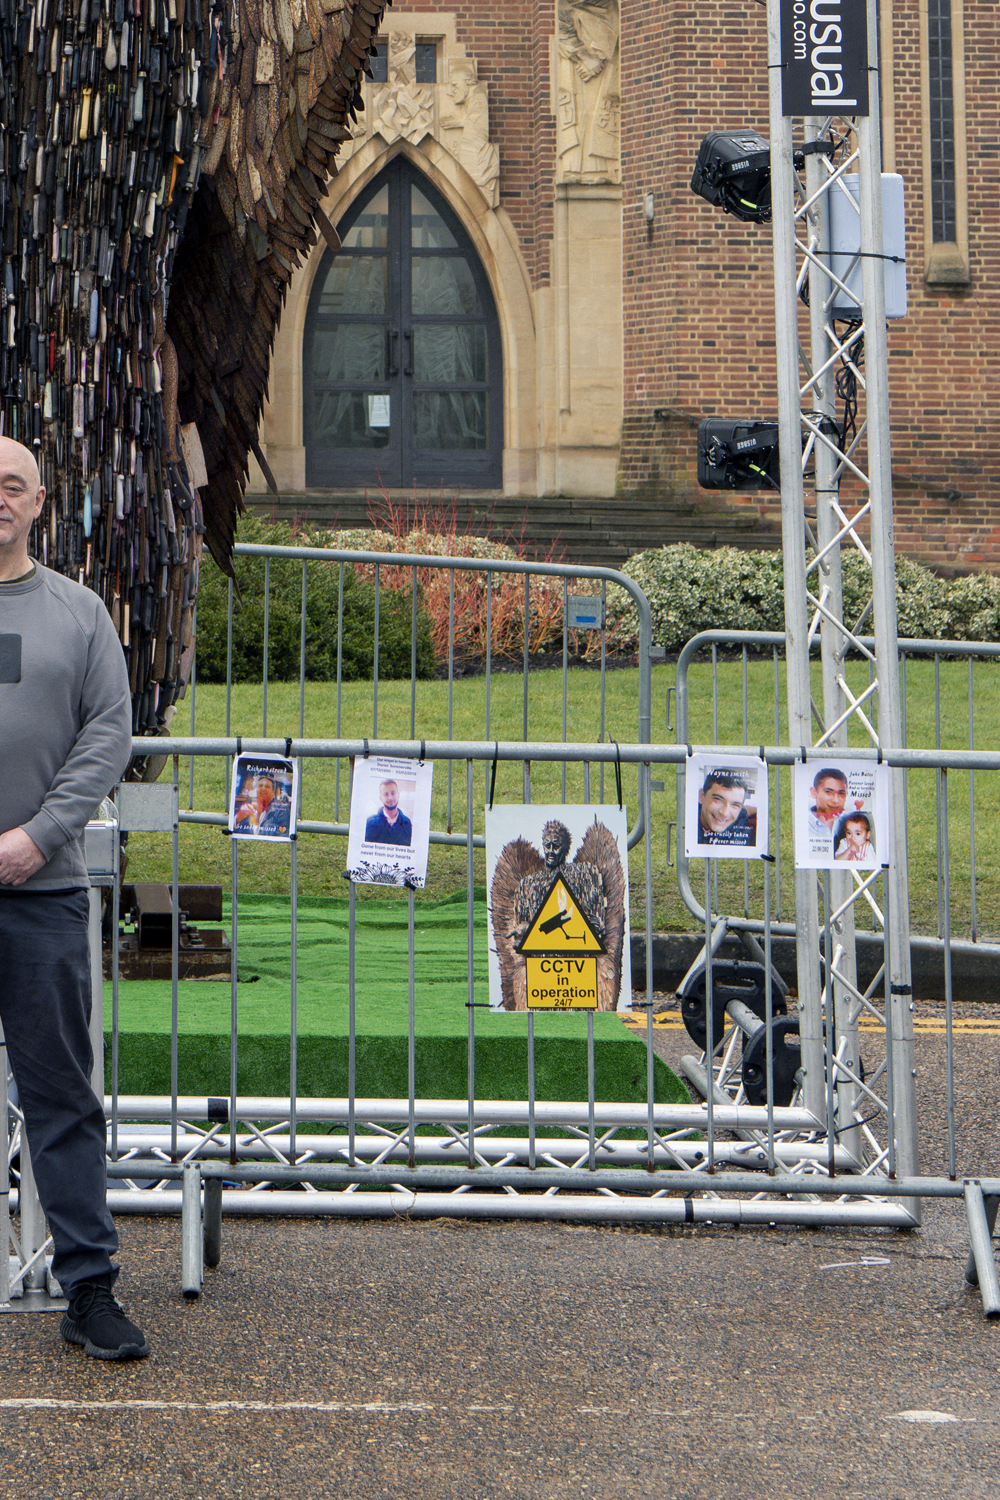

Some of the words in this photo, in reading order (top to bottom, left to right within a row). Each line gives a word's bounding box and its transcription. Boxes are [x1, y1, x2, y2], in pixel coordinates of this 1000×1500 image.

[246, 764, 268, 773] Richard
[707, 768, 729, 778] Wayne
[729, 770, 750, 778] smith
[850, 790, 871, 798] Missed
[540, 959, 585, 973] CCTV
[556, 974, 569, 985] in
[531, 986, 595, 1000] operation
[554, 998, 573, 1007] 24/7
